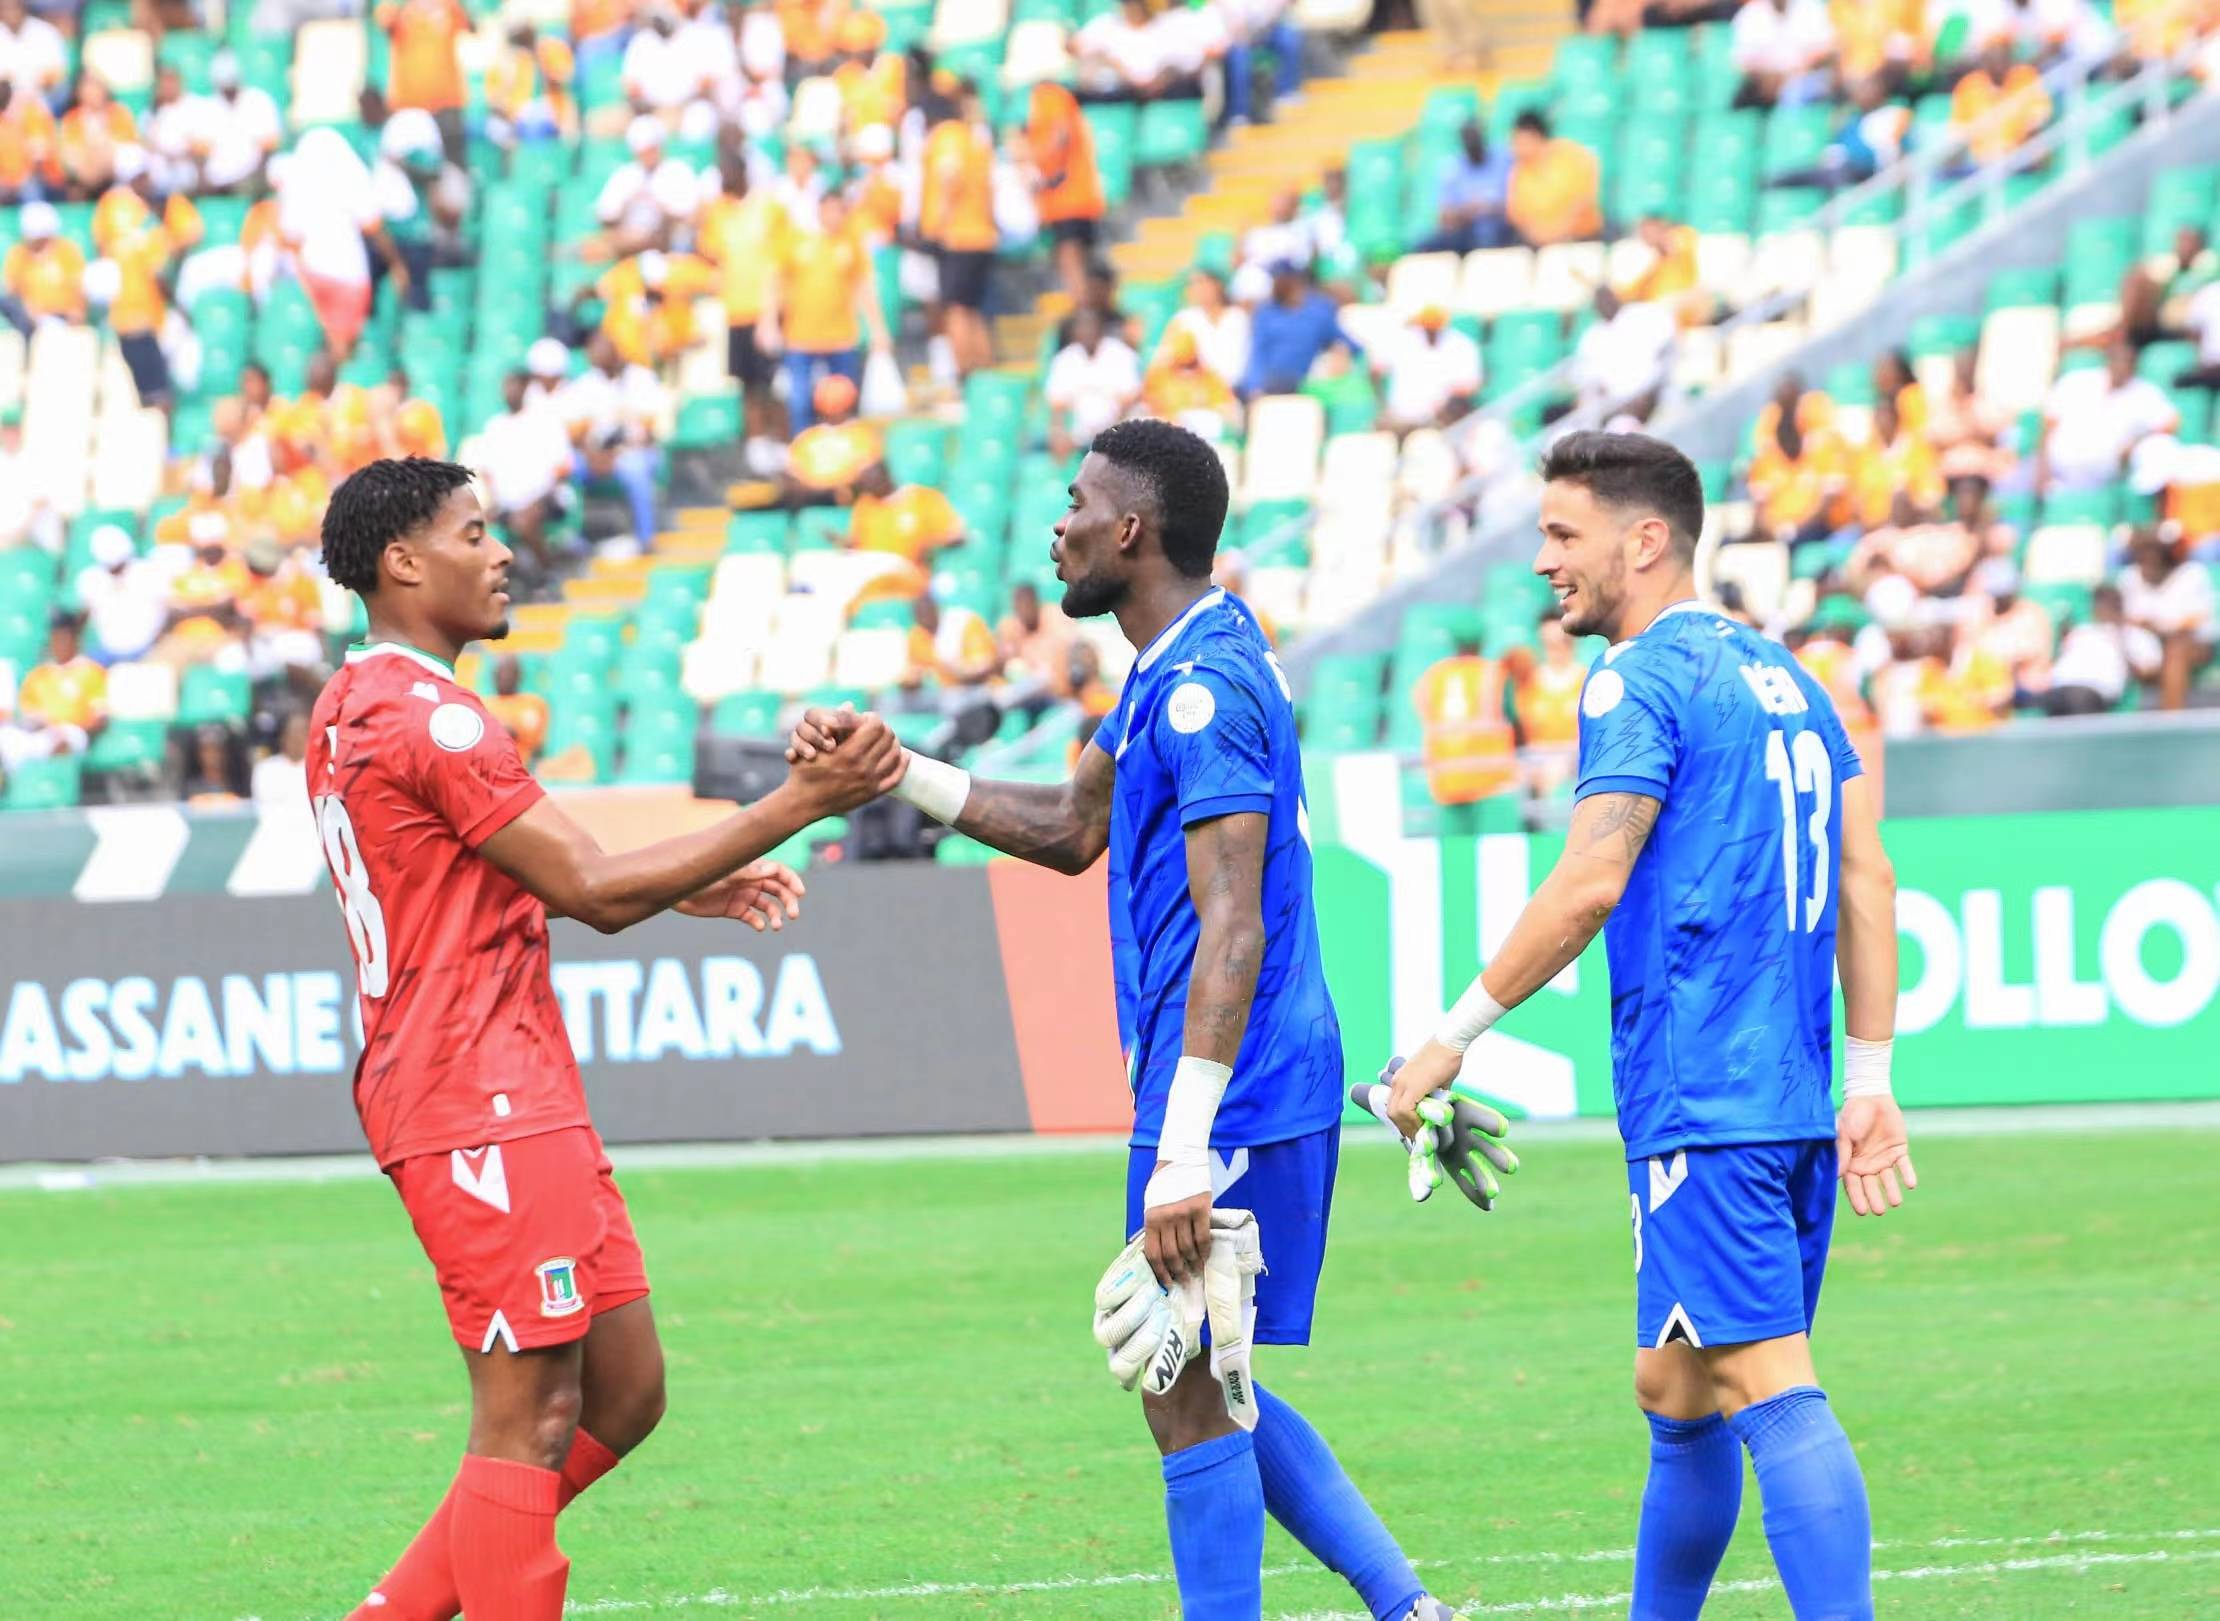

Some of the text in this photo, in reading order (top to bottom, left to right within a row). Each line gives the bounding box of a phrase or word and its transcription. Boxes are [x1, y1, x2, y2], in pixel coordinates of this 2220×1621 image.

[1765, 729, 1832, 933] 13
[0, 953, 843, 1083] ASSANE TTARA
[1834, 874, 2220, 1035] OLLO
